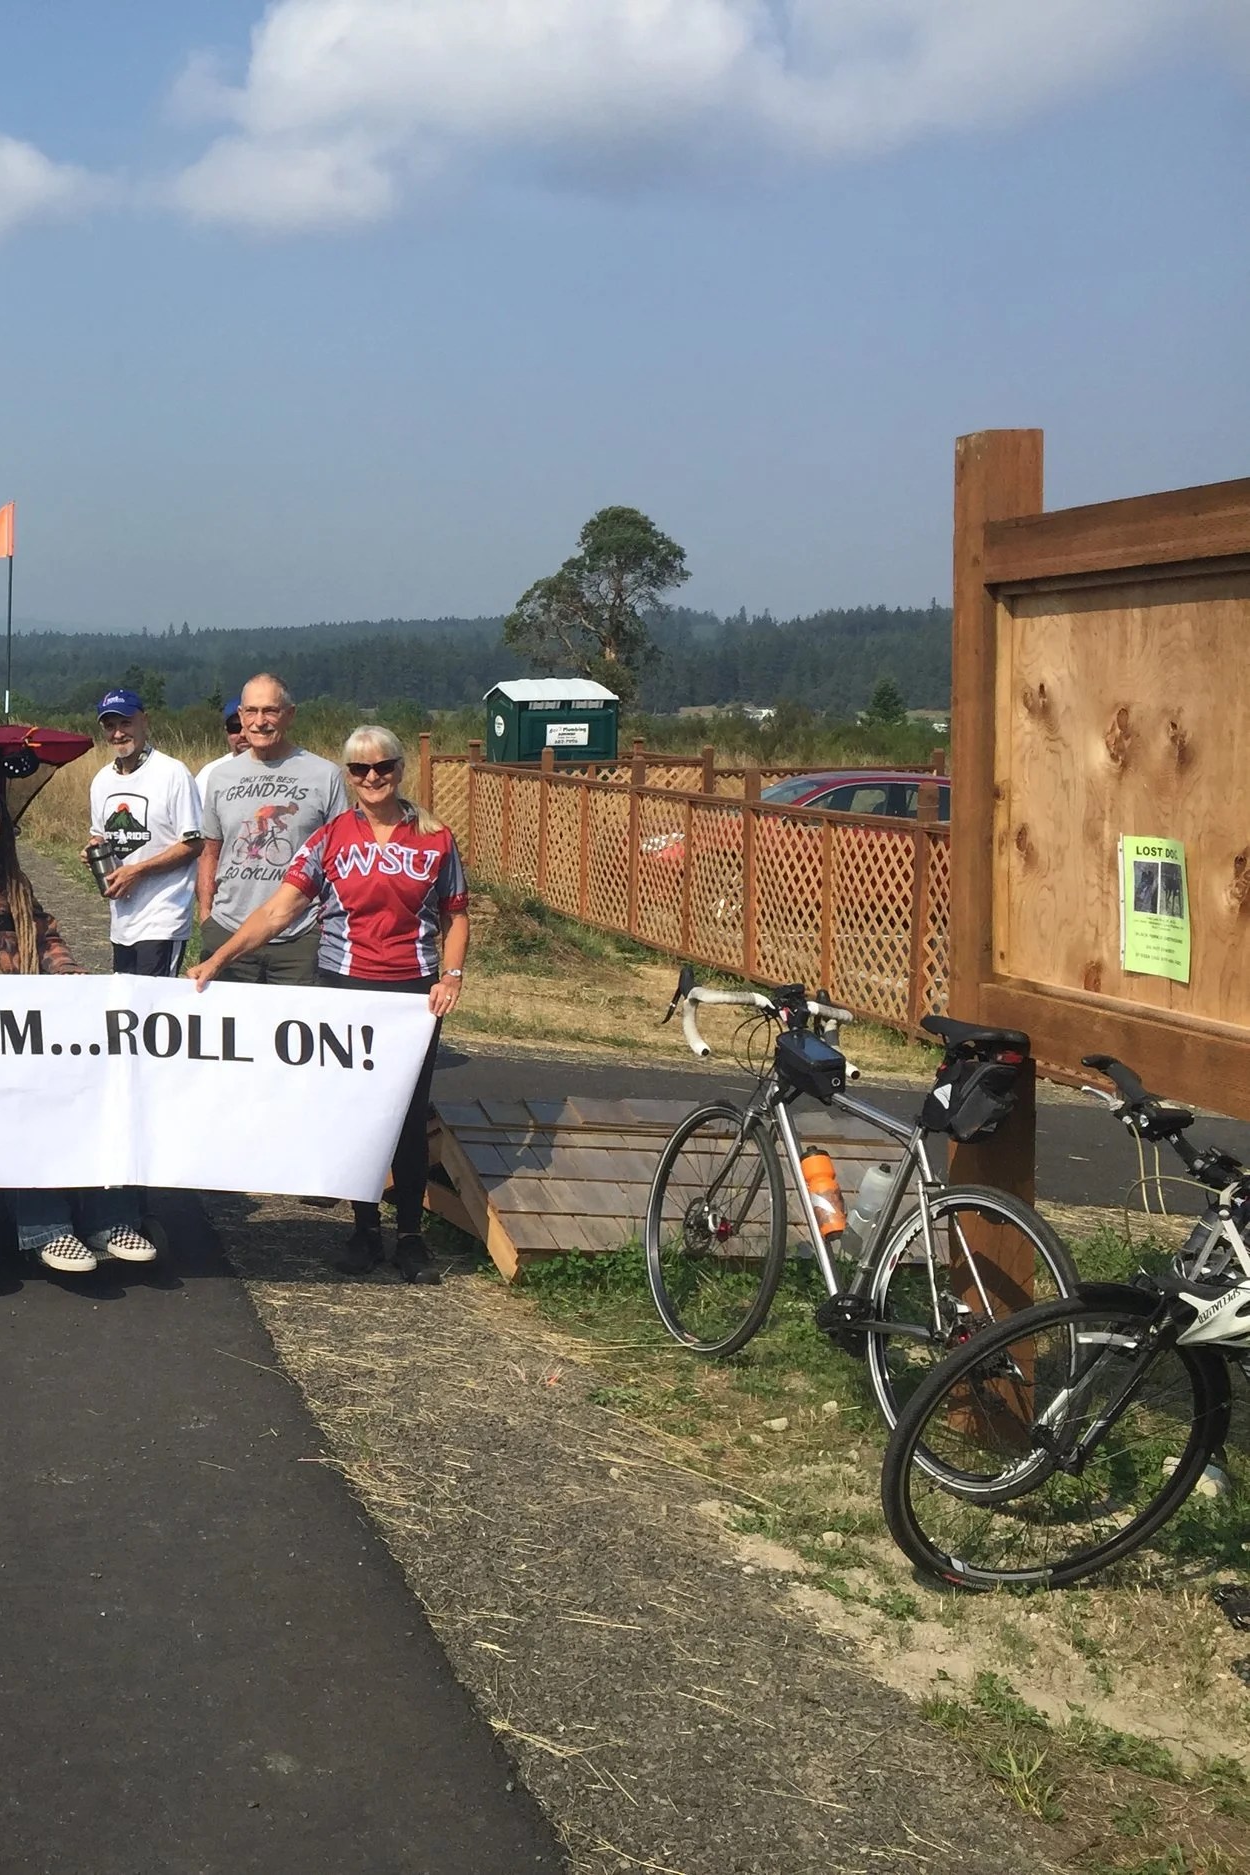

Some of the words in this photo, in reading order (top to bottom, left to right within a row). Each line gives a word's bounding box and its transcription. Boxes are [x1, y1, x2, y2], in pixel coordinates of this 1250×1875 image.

[240, 776, 258, 784] ONLY
[276, 775, 299, 784] BEST
[226, 782, 309, 801] GRANDPAS
[126, 831, 150, 841] RIDE
[1136, 846, 1163, 857] LOST
[334, 841, 440, 881] WSU
[226, 866, 240, 879] GO
[241, 866, 287, 880] CYCLIN
[274, 1019, 375, 1071] ON!
